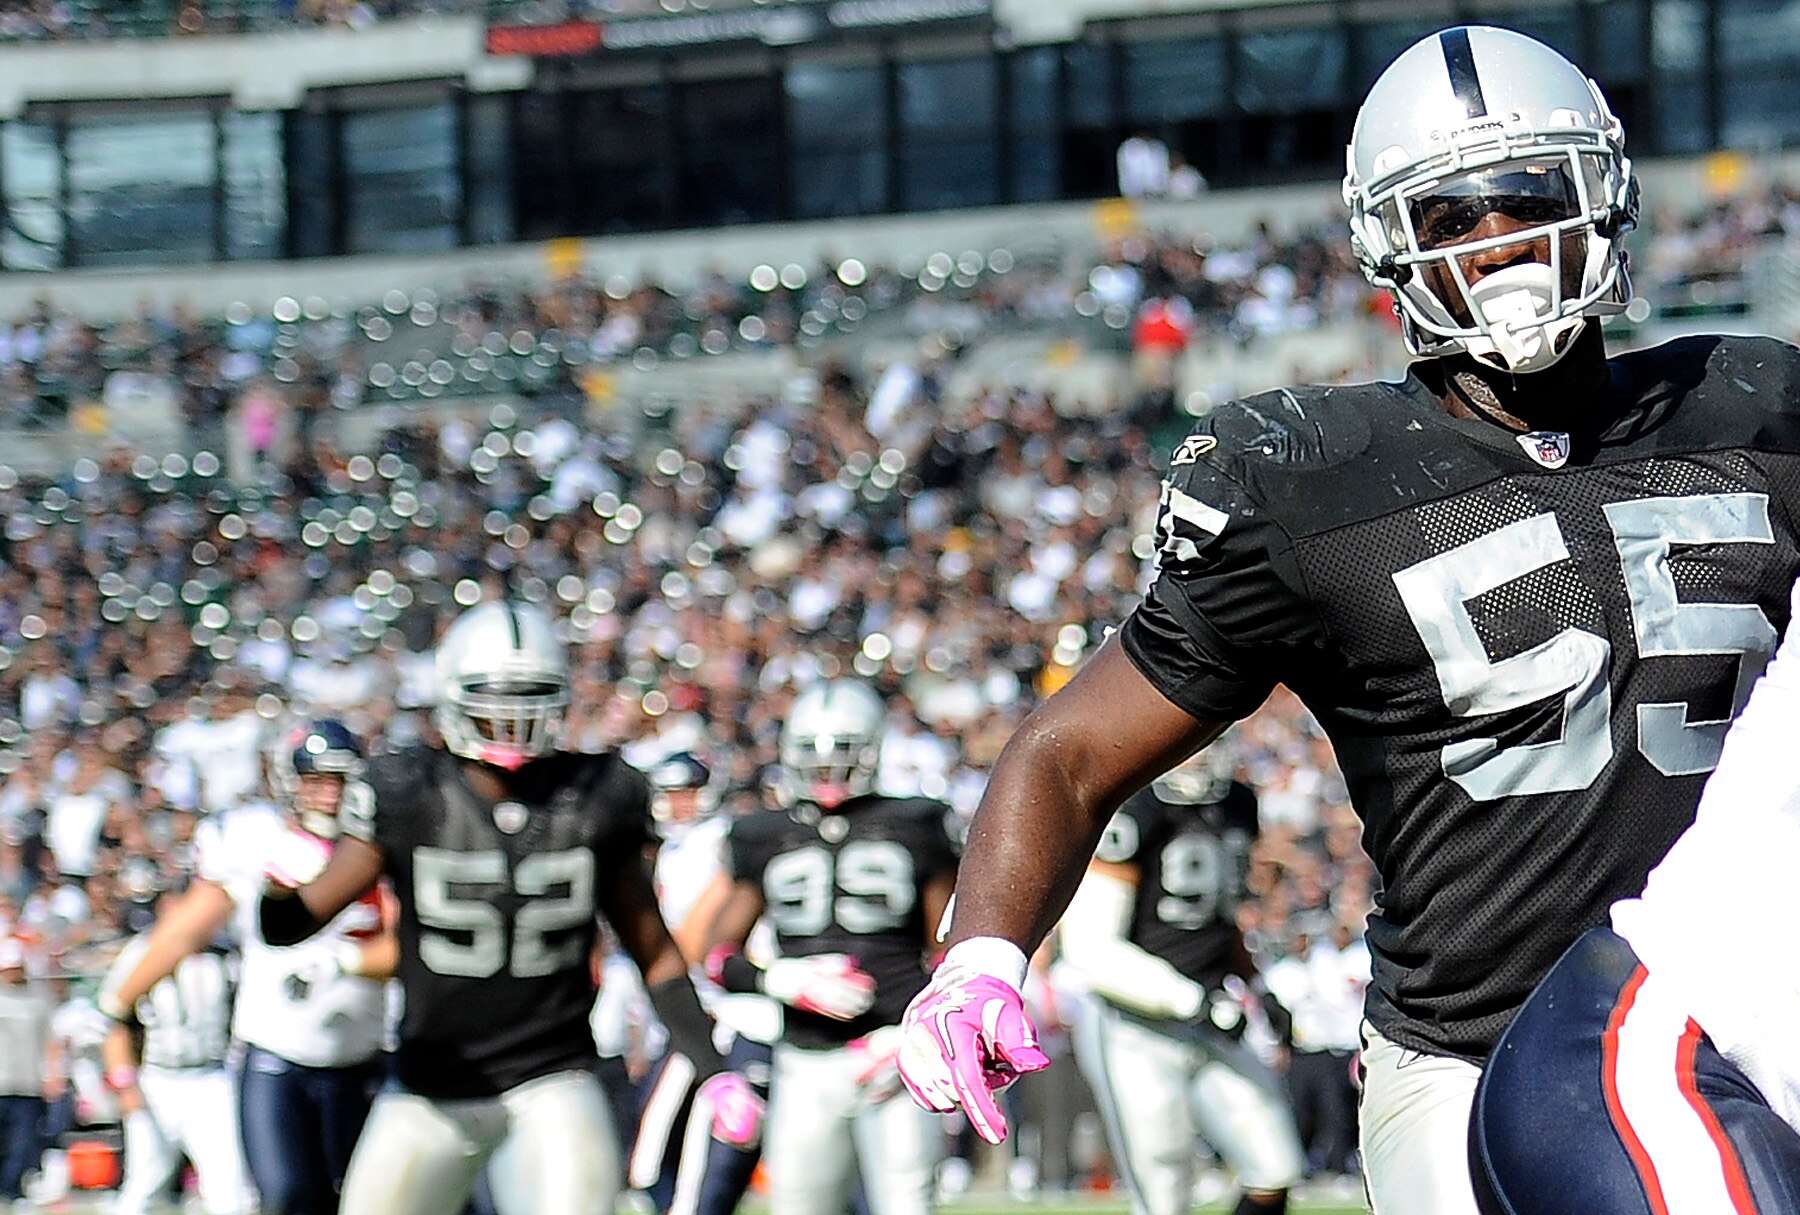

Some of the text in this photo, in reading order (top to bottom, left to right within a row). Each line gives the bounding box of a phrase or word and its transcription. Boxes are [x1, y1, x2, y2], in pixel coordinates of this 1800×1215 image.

[1392, 492, 1777, 801] 55
[412, 845, 597, 979] 52
[763, 838, 916, 936] 99
